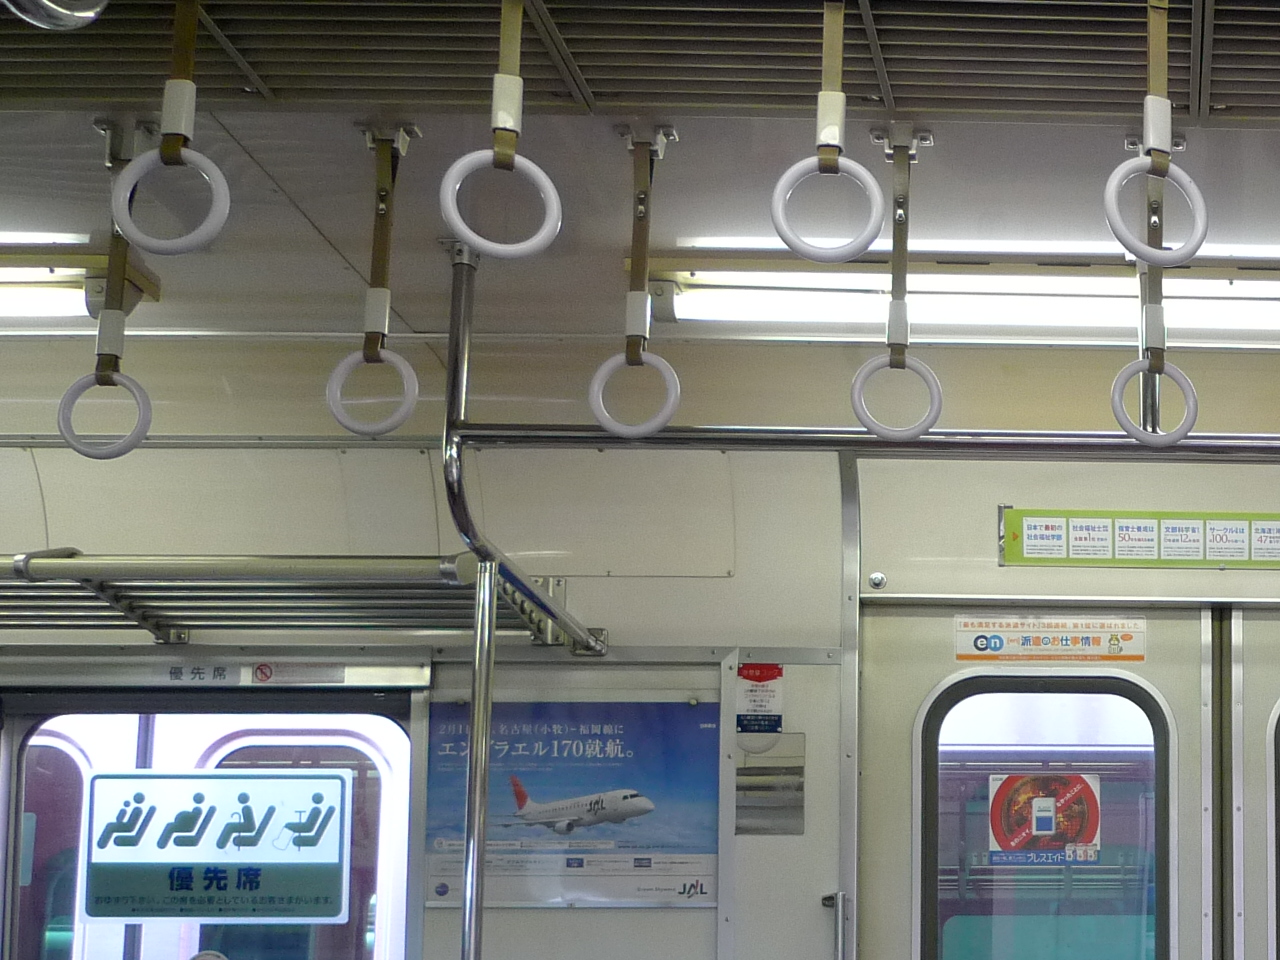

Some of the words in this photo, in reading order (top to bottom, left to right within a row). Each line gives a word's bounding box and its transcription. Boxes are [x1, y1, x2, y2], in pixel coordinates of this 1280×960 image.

[1257, 536, 1268, 544] 47
[976, 636, 1002, 650] en
[169, 666, 228, 681] 優先席
[438, 740, 634, 759] エンラエル170就航。
[586, 798, 606, 814] JAL
[168, 866, 262, 892] 優先席
[678, 880, 708, 898] JAL
